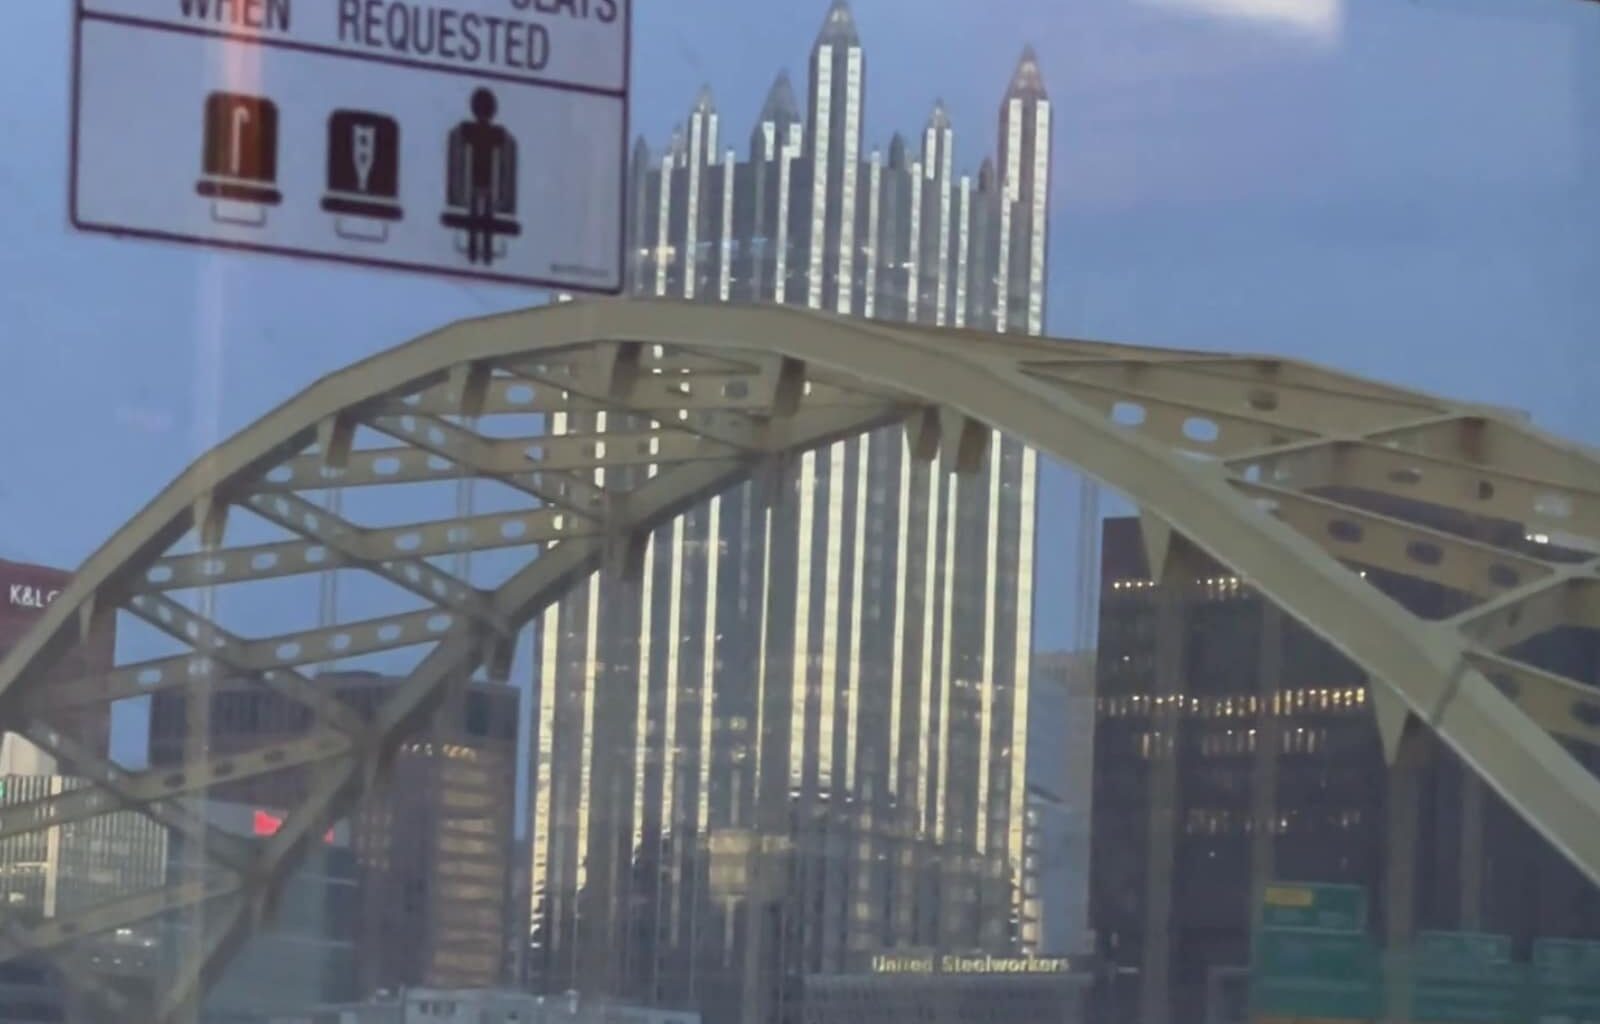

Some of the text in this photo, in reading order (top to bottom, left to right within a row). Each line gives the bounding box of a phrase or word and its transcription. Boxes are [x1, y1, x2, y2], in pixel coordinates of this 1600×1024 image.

[337, 0, 550, 71] REQUESTED
[10, 583, 44, 608] K&L
[872, 954, 1069, 973] United Steelworkers
